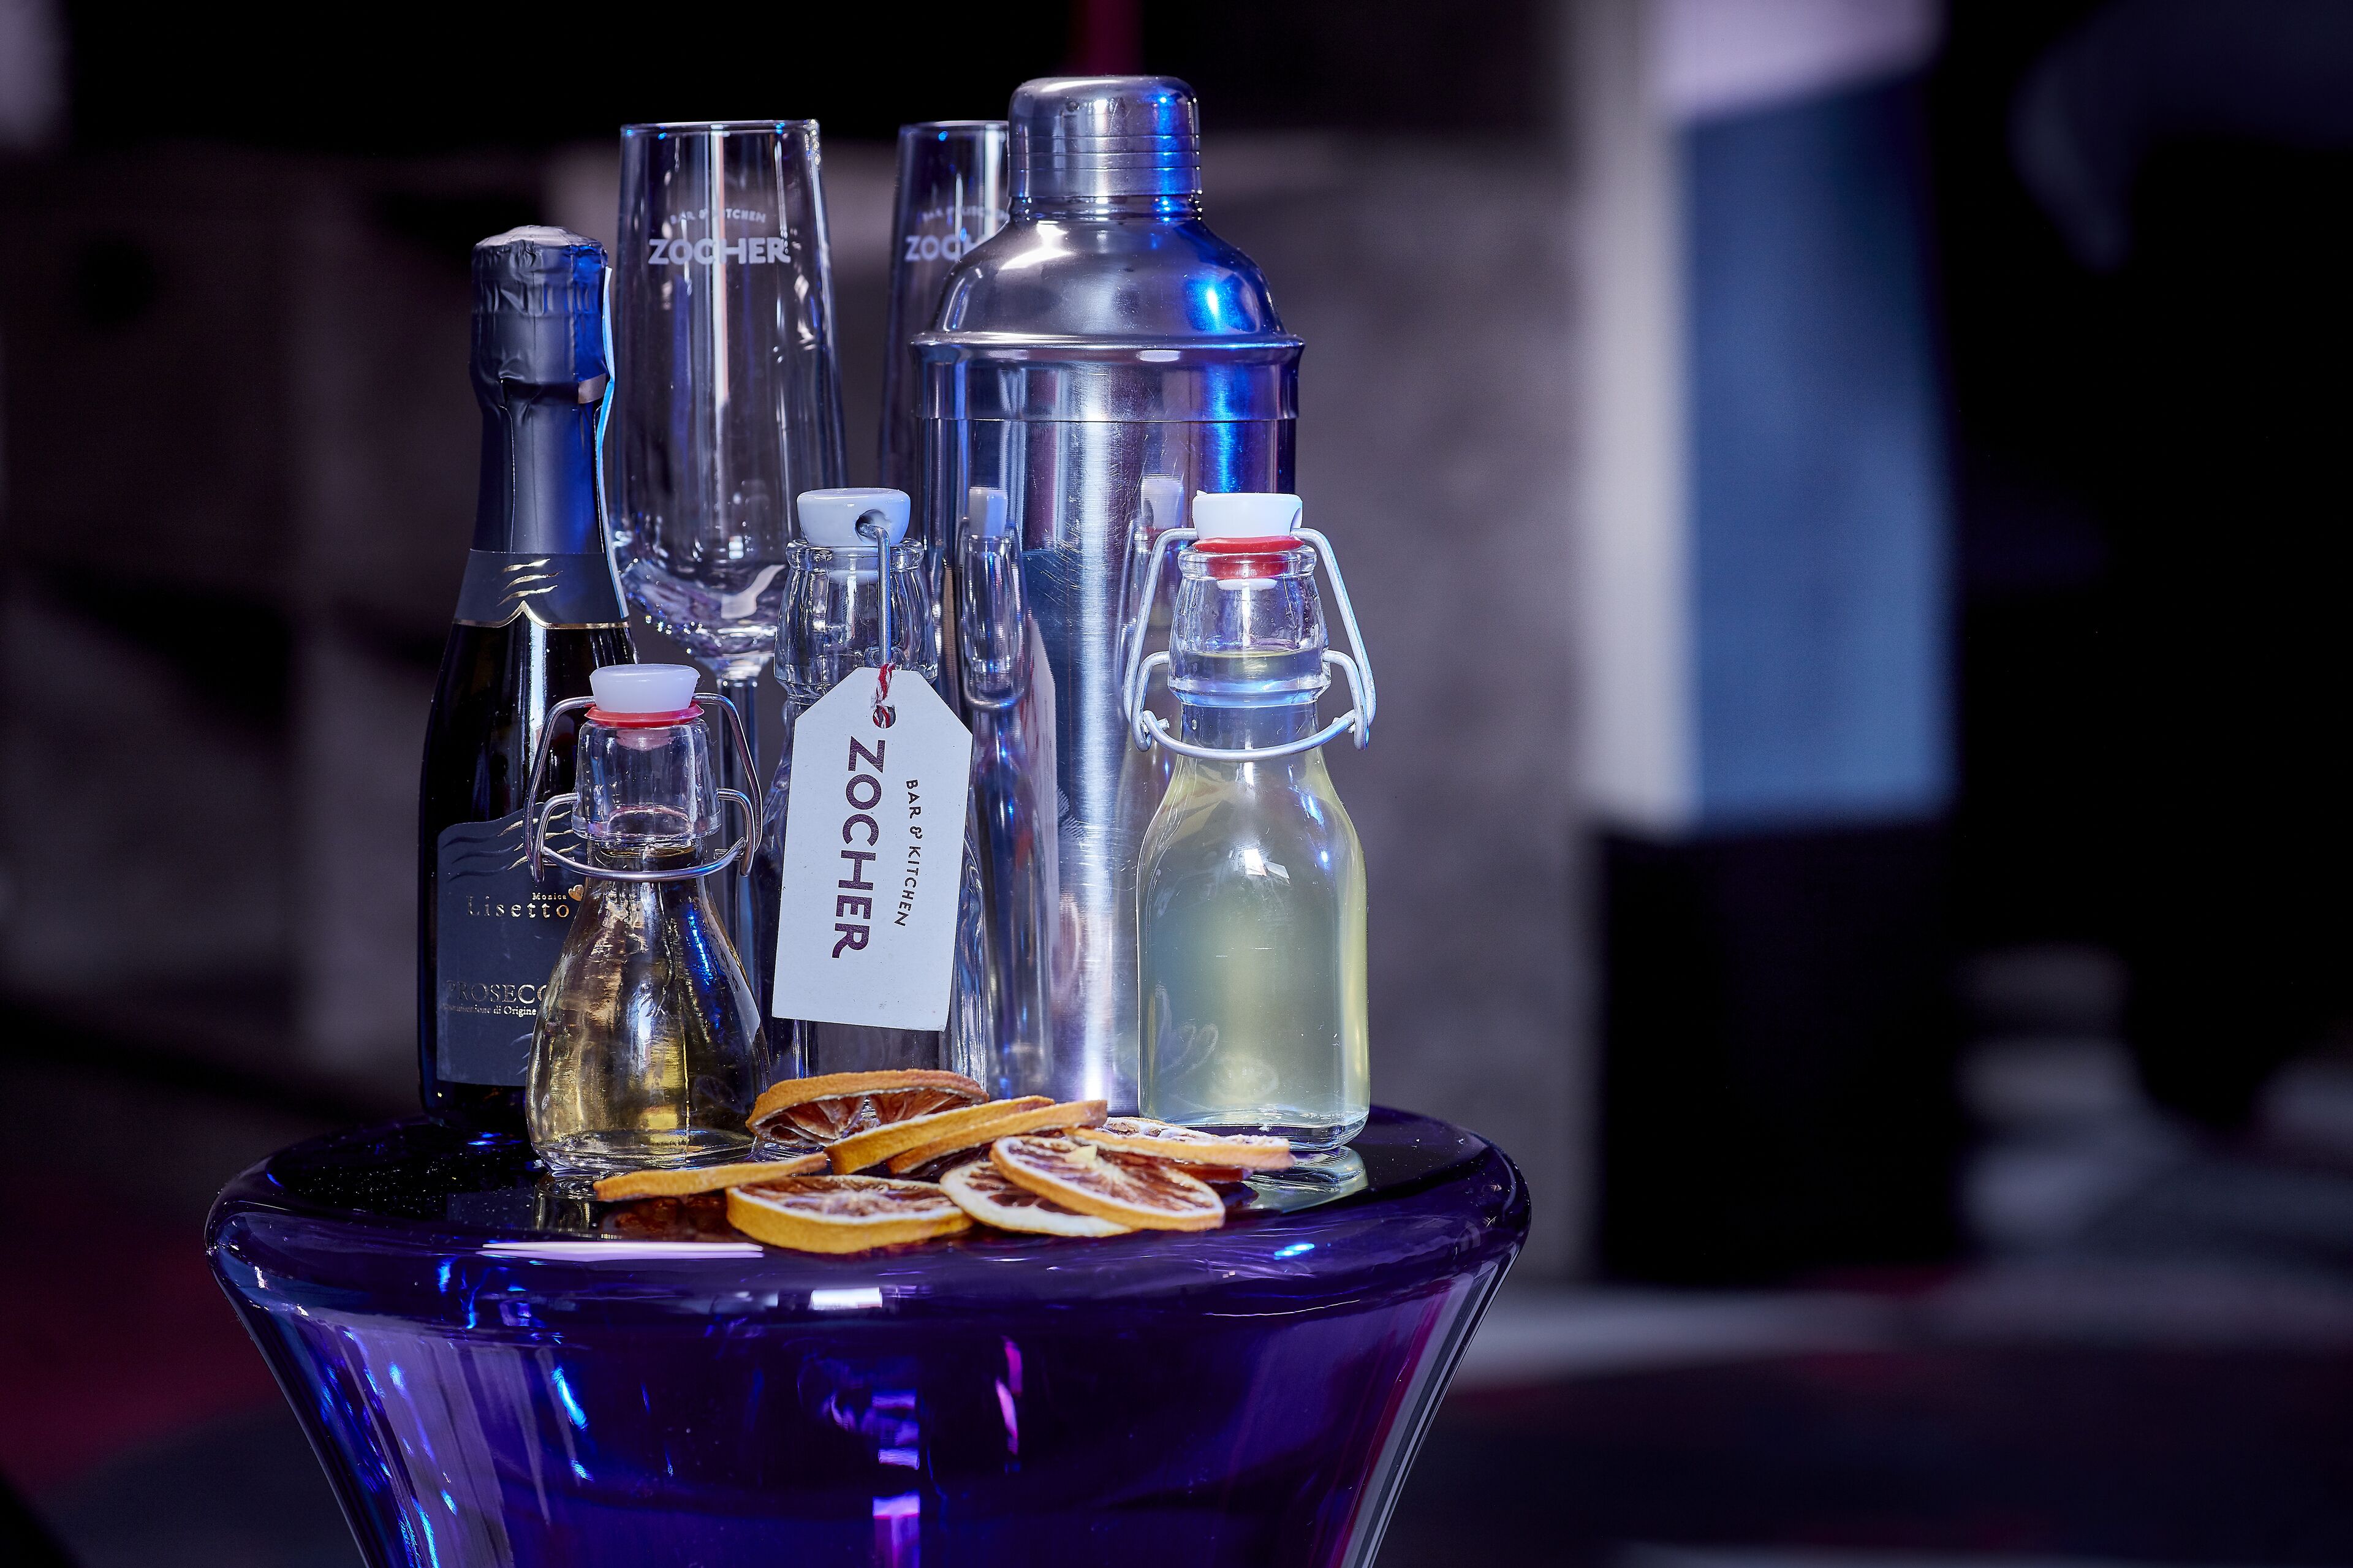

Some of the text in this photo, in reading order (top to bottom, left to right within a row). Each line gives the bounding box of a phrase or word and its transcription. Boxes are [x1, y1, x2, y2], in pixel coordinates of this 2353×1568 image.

[648, 237, 791, 265] ZOCHER
[832, 735, 885, 958] ZOCHER
[893, 779, 923, 926] BAR & KITCHEN
[466, 895, 569, 918] Lisetto
[503, 1006, 537, 1018] Origine
